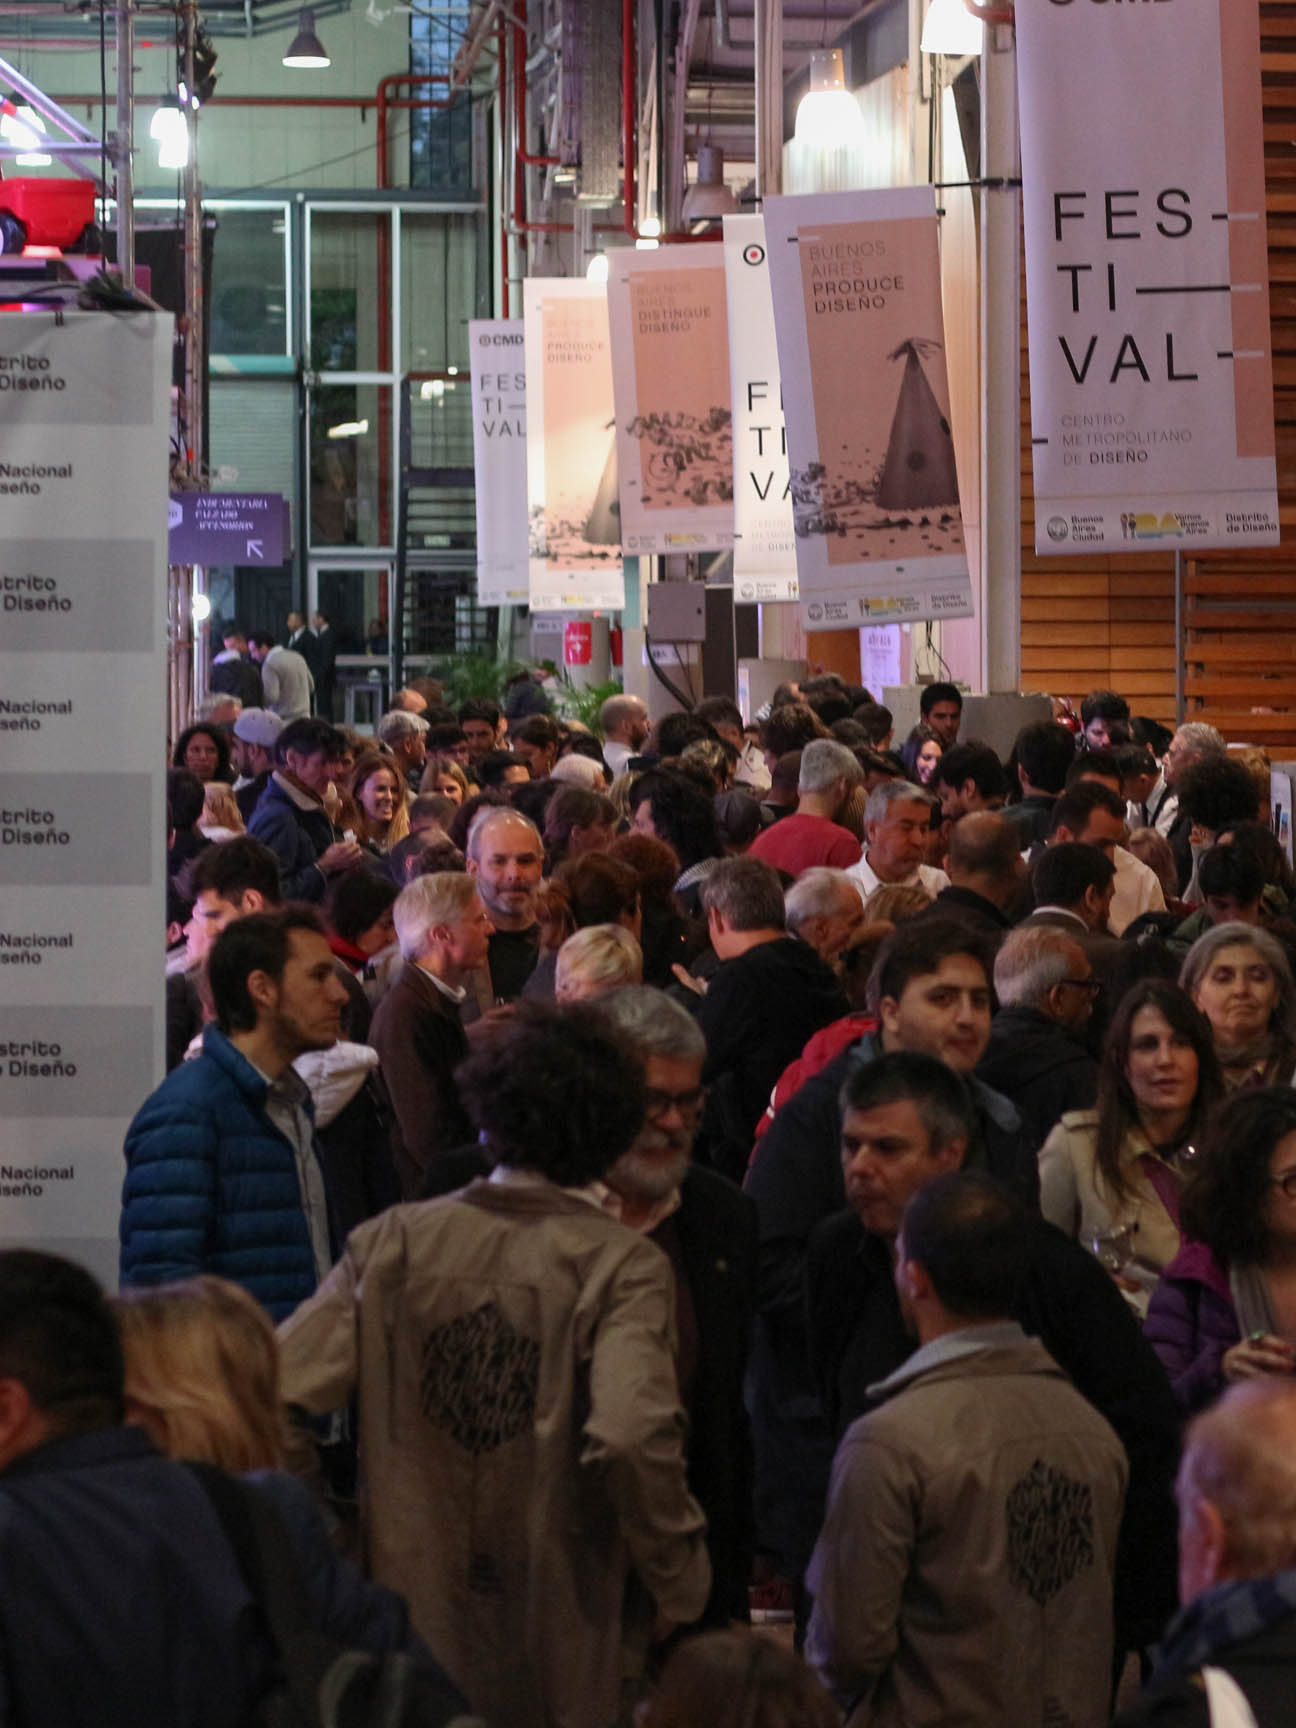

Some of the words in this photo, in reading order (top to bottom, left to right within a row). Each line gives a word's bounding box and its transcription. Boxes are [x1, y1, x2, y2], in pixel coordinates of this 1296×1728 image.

[1054, 188, 1193, 241] FES
[813, 275, 905, 296] PRODUCE
[1058, 333, 1198, 385] VAL
[481, 373, 526, 391] FES
[482, 420, 527, 437] VAL
[1061, 413, 1125, 427] CENTRO
[1062, 429, 1193, 447] METROPOLITANO
[1063, 453, 1081, 466] DE
[1089, 447, 1148, 465] DISEÑO
[0, 463, 72, 478] Nacional
[1226, 512, 1269, 523] Distrito
[1227, 524, 1240, 534] de
[0, 574, 56, 591] trito
[4, 594, 72, 611] Diseño
[0, 699, 72, 714] Nacional
[2, 828, 70, 845] Diseño
[0, 933, 73, 948] Nacional
[9, 1060, 77, 1077] Diseño
[1, 1165, 74, 1180] Nacional
